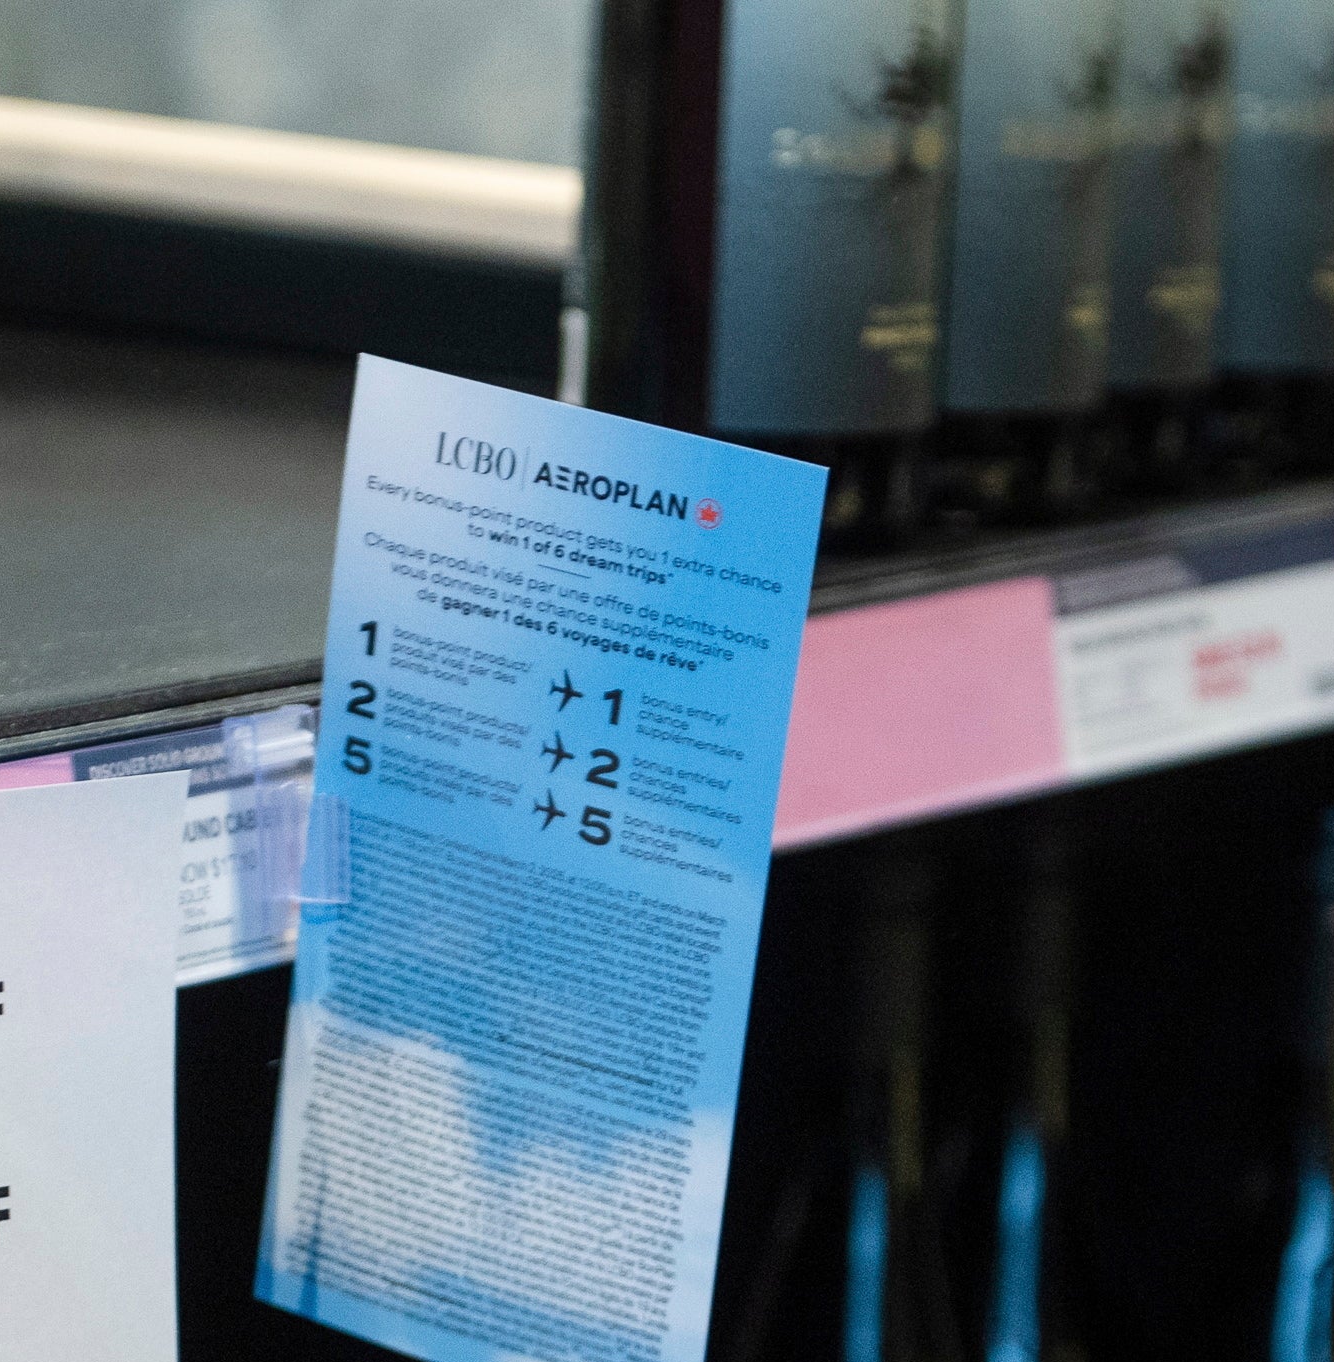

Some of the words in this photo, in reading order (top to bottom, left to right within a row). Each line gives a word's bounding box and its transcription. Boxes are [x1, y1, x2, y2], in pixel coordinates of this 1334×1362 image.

[436, 432, 516, 481] LCBO
[534, 463, 689, 521] AEROPLAN
[367, 475, 410, 501] Every
[414, 490, 513, 526] bonus-point
[516, 517, 583, 544] product
[586, 535, 623, 554] gets
[628, 547, 657, 562] you
[662, 551, 669, 564] 1
[672, 557, 715, 577] extra
[718, 567, 782, 594] chance
[468, 524, 484, 538] to
[489, 532, 518, 545] win
[523, 536, 529, 548] 1
[533, 541, 551, 554] of
[554, 544, 564, 558] 6
[569, 550, 624, 573] dream
[364, 531, 426, 561] Chaque
[429, 552, 489, 578] produit
[493, 571, 523, 586] visé
[527, 578, 555, 593] par
[559, 589, 590, 603] une
[594, 594, 633, 615] offre
[637, 606, 660, 622] de
[662, 613, 769, 650] points-bonis
[392, 565, 426, 581] vous
[431, 573, 498, 600] donnera
[503, 595, 533, 609] une
[536, 601, 597, 626] chance
[602, 618, 734, 662] supplémentaire
[417, 589, 438, 604] de
[442, 596, 499, 618] gagner
[503, 609, 509, 622] 1
[513, 615, 542, 632] des
[547, 621, 557, 635] 6
[563, 630, 630, 655] voyages
[634, 646, 656, 661] de
[360, 621, 377, 656] 1
[346, 680, 377, 719] 2
[603, 689, 623, 726] 1
[343, 736, 372, 775] 5
[585, 748, 620, 789] 2
[578, 806, 611, 846] 5
